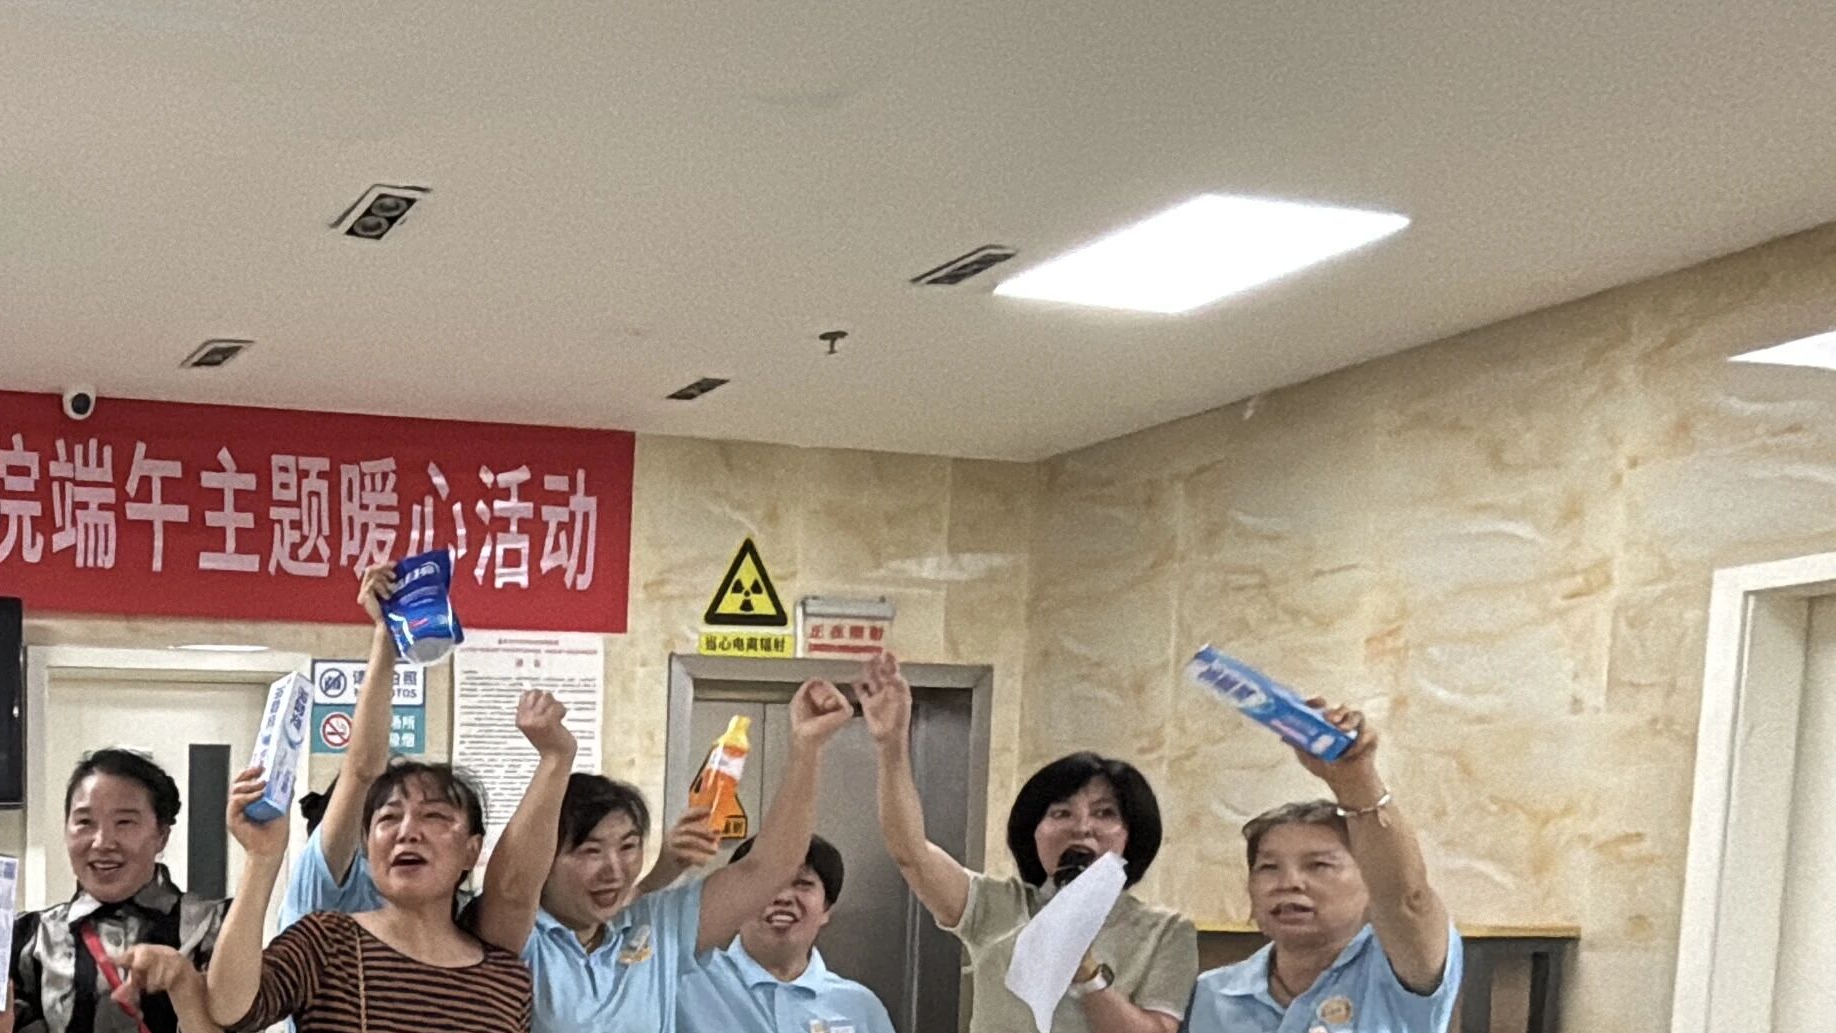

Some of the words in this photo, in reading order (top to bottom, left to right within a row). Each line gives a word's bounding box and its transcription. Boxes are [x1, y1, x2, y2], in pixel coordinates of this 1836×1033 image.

[705, 635, 787, 654] 当心电离辐射
